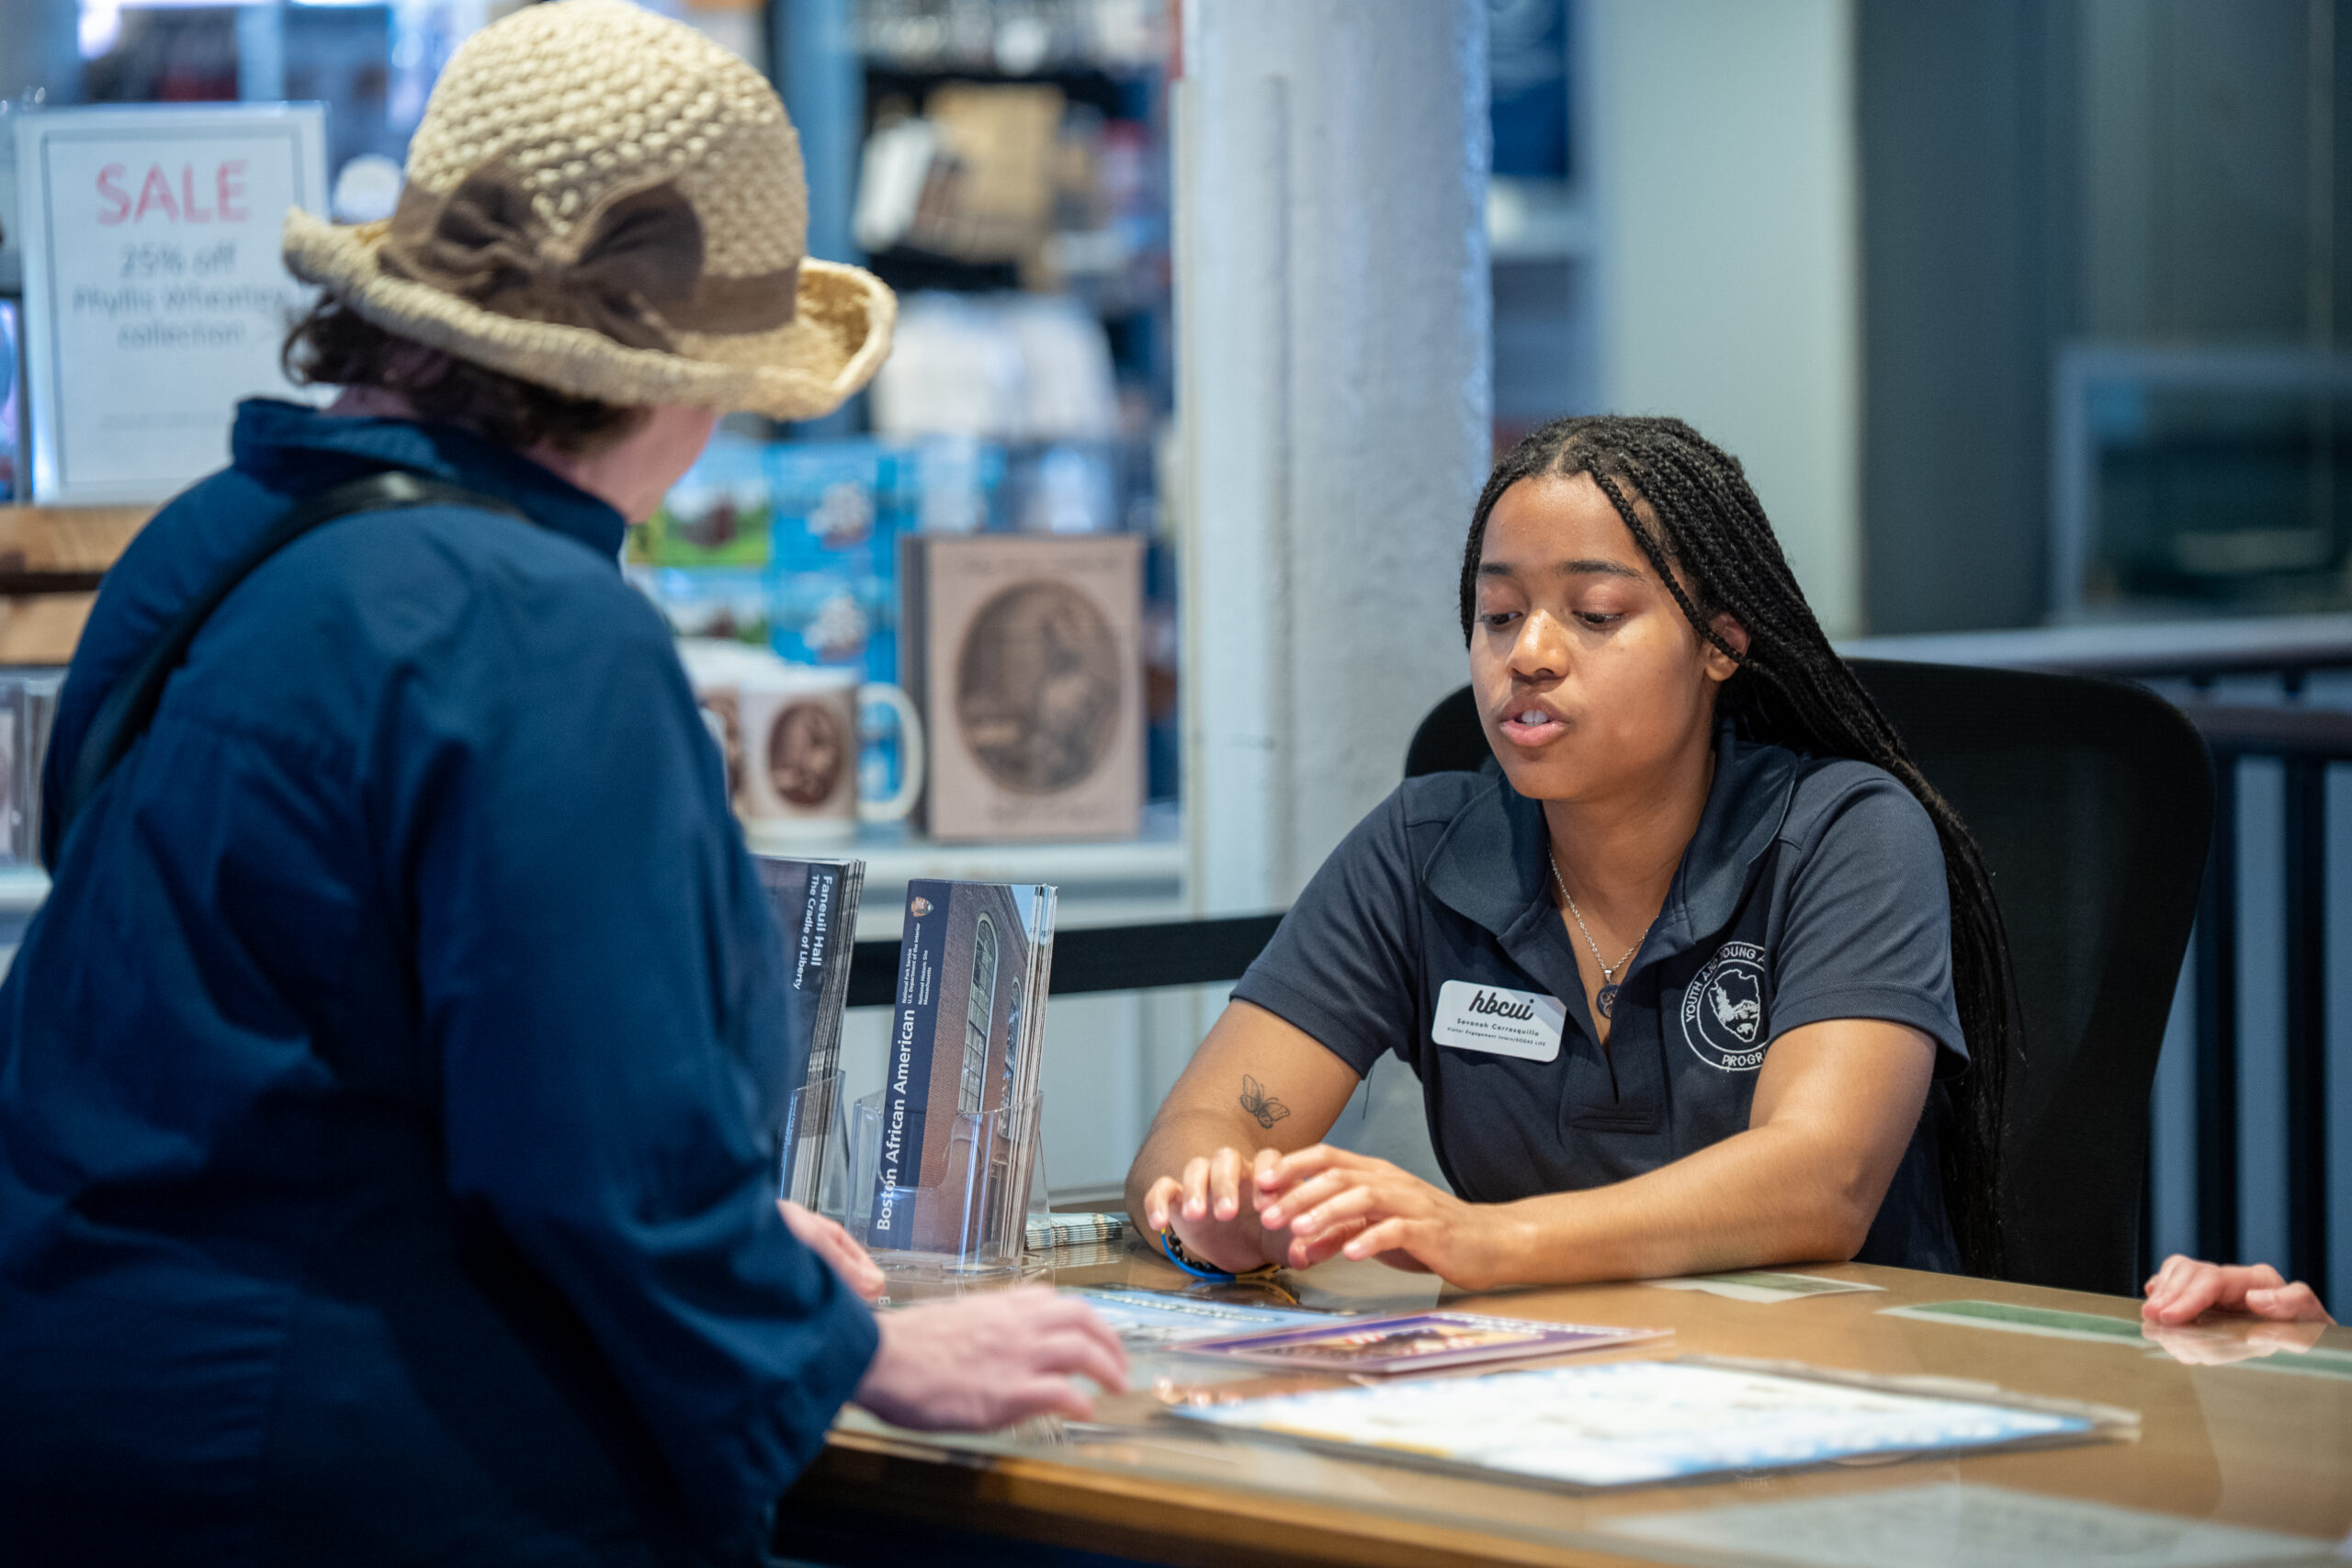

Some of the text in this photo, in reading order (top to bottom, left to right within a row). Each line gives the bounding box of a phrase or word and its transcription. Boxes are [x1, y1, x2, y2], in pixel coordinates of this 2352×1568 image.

[96, 160, 249, 226] SALE
[119, 237, 237, 279] 25% off
[117, 319, 246, 352] collection
[794, 874, 820, 990] The Cradle of Liberty
[810, 875, 833, 966] Faneuil Hall
[911, 952, 918, 960] of
[920, 961, 928, 981] Historic
[908, 960, 917, 993] Department
[923, 966, 932, 1006] Massachusetts
[1686, 981, 1702, 1022] YOUTH
[1720, 945, 1757, 960] YOUNG
[1469, 989, 1534, 1021] hbcui
[1465, 1030, 1497, 1039] Engagement
[1491, 1023, 1540, 1037] Carrasquillo
[1722, 1049, 1766, 1066] PROGR
[876, 1010, 915, 1231] Boston African American
